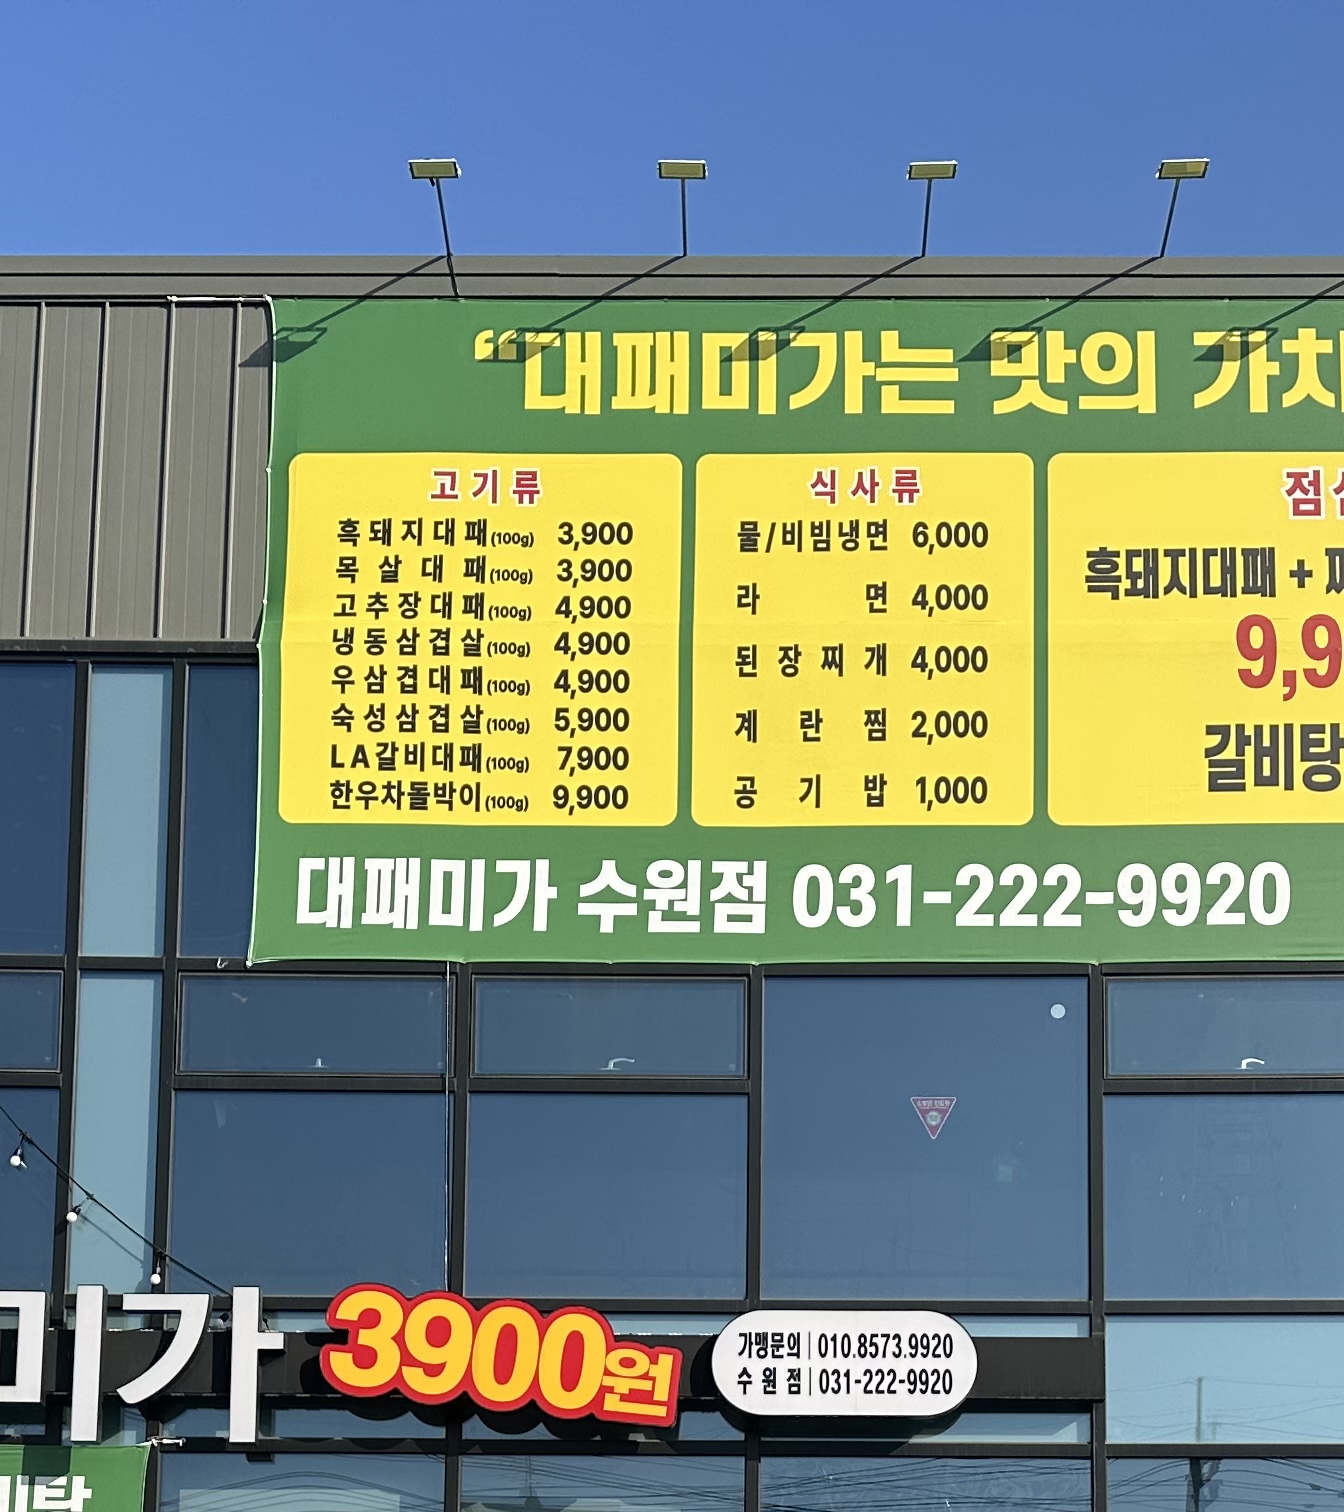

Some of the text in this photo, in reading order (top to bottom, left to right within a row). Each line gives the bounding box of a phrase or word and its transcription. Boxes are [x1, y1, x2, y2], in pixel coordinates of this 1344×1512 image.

[989, 329, 1157, 415] 맛의
[430, 468, 544, 504] 고기류
[809, 468, 922, 504] 식사류
[556, 521, 634, 549] 3,900
[736, 520, 989, 553] 물/비빔냉면 6,000
[556, 558, 634, 586] 3,900
[1084, 547, 1277, 599] 흑돼지대패
[554, 595, 632, 623] 4,900
[911, 584, 989, 614] 4,000
[553, 631, 631, 659] 4,900
[910, 647, 989, 676] 4,000
[553, 668, 631, 697] 4,900
[552, 707, 631, 736] 5,900
[910, 711, 989, 741] 2,000
[556, 745, 630, 774] 7,900
[552, 784, 629, 813] 9,900
[913, 777, 989, 806] 1,000
[295, 856, 559, 934] 대패미가
[577, 858, 767, 934] 수원점
[791, 862, 1292, 930] 031-222-9920
[330, 1289, 675, 1419] 3900원
[738, 1331, 954, 1359] 가맹문의 010.8573.9920
[818, 1369, 953, 1396] 031-222-9920
